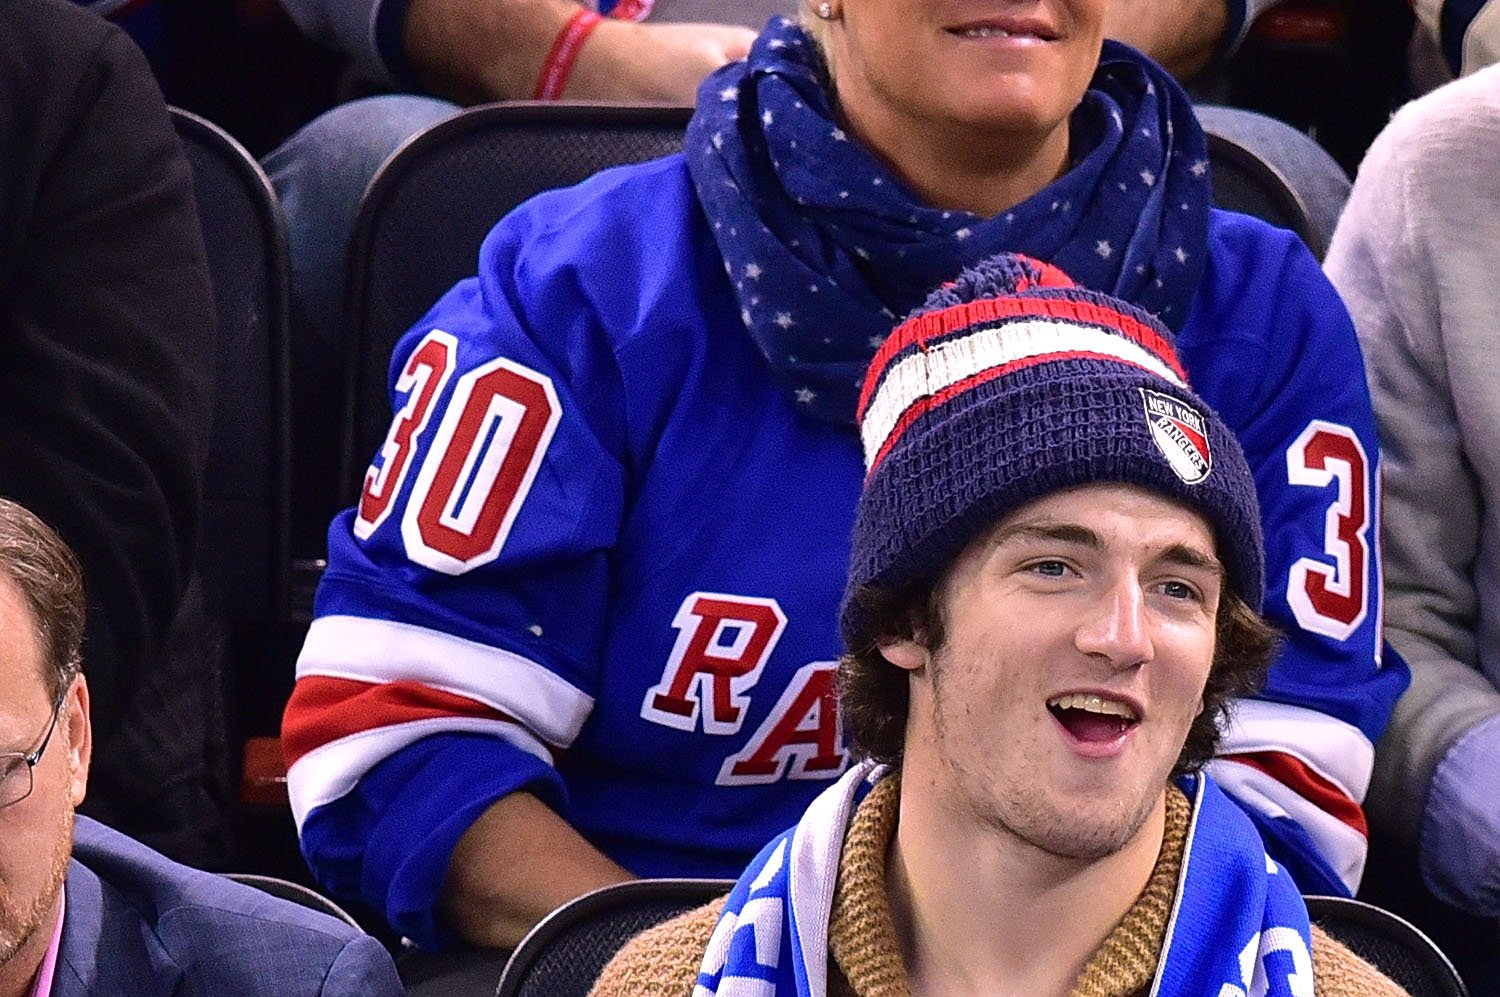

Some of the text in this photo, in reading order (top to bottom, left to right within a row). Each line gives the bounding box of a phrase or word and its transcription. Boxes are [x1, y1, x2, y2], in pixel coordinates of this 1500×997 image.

[352, 328, 563, 577] 30
[1148, 396, 1203, 433] NEW YORK
[1157, 418, 1203, 470] RANGERS
[1286, 419, 1370, 642] 3
